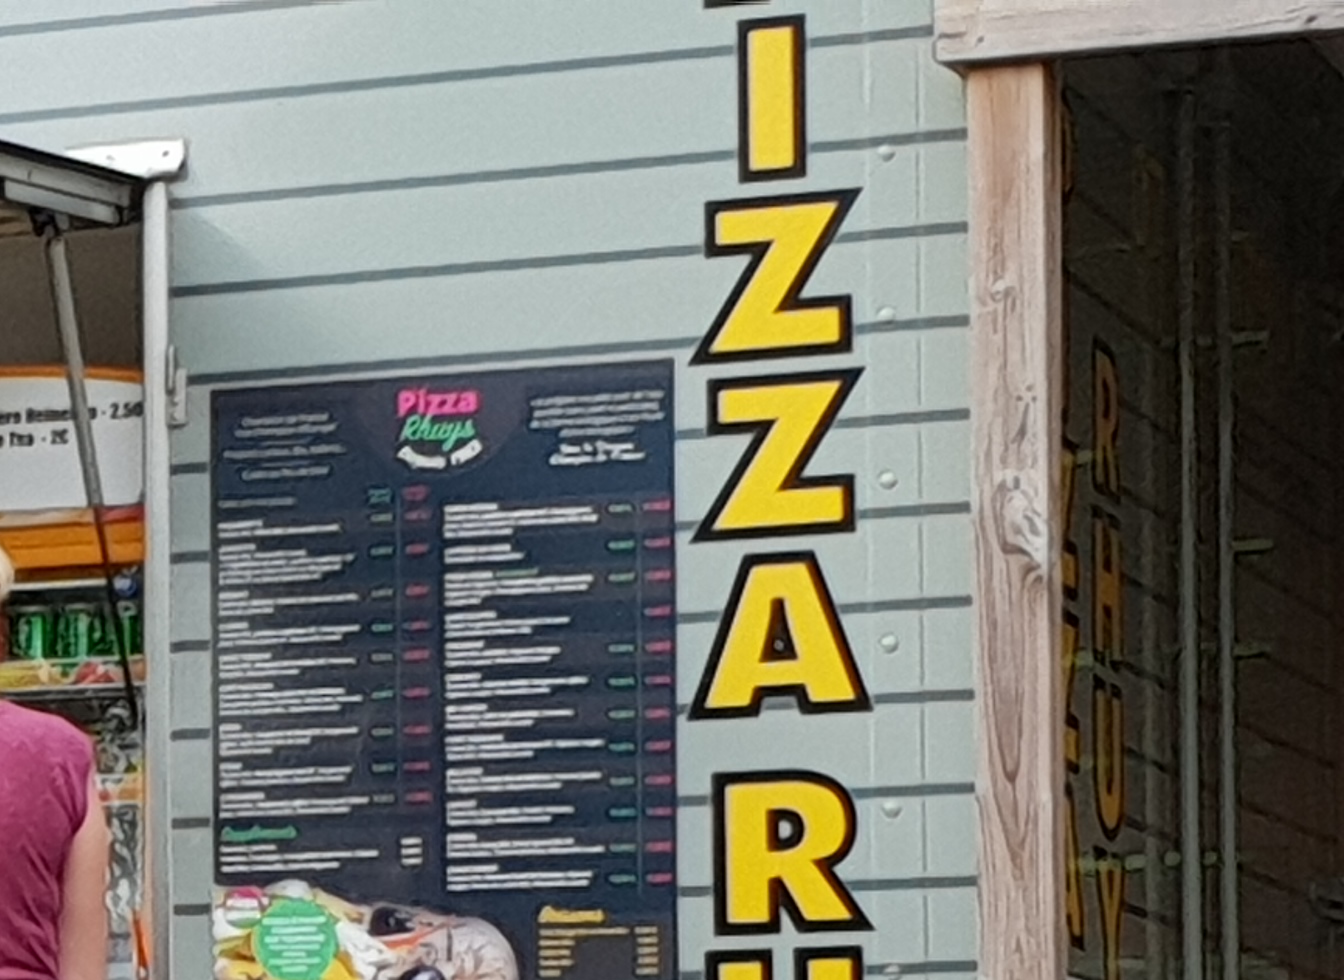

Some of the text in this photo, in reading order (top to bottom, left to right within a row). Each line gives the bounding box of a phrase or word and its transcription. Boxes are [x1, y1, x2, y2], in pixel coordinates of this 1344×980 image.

[687, 0, 873, 721] IZZA
[397, 387, 479, 418] Pizza
[398, 415, 476, 453] Rhuys
